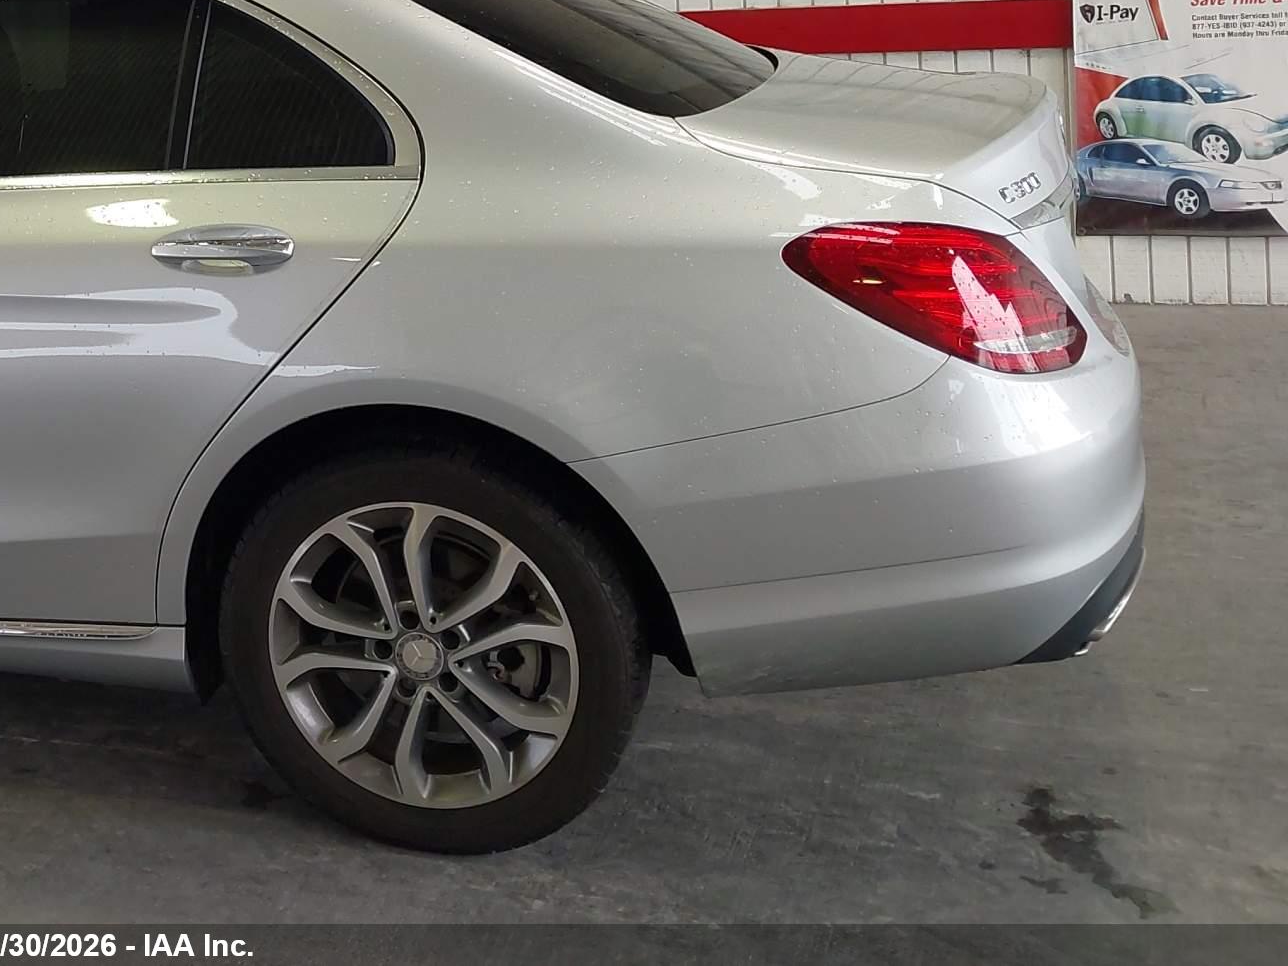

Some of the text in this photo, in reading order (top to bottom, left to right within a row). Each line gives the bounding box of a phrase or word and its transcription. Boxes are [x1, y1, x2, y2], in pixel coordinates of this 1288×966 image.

[1096, 4, 1139, 21] I-Pay
[1219, 13, 1238, 21] Buyer
[1240, 12, 1269, 20] Services
[1193, 31, 1212, 39] Hours
[1227, 30, 1254, 38] Monday
[998, 172, 1041, 203] C300
